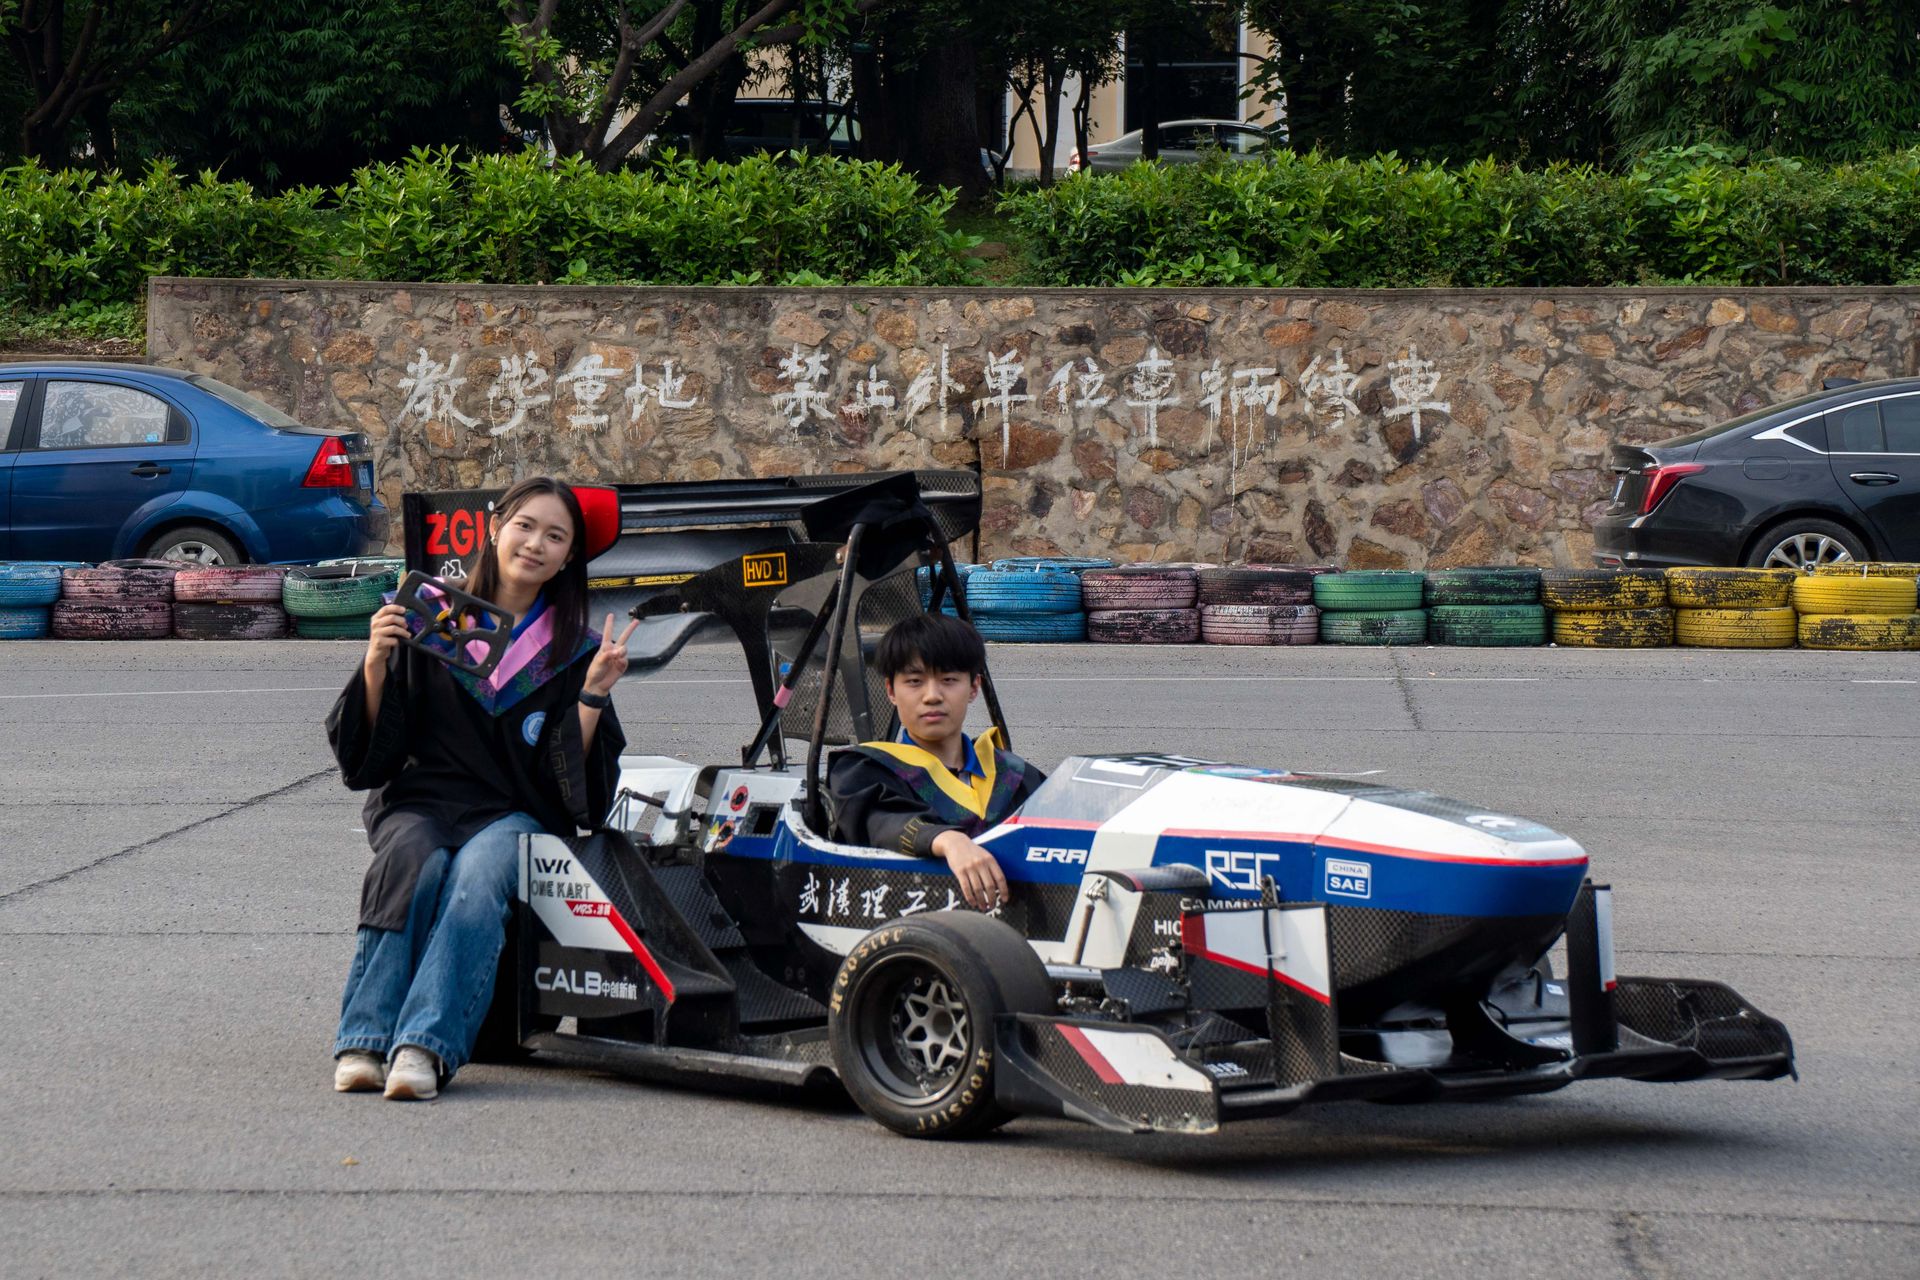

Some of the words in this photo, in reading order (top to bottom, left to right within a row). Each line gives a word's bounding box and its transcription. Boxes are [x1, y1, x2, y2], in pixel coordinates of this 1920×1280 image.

[746, 560, 772, 580] HVD
[1025, 846, 1088, 865] ERA
[1332, 864, 1363, 874] CHINA
[531, 880, 554, 897] ONE
[556, 882, 591, 900] KART
[1330, 876, 1366, 892] SAE
[534, 966, 602, 996] CALB
